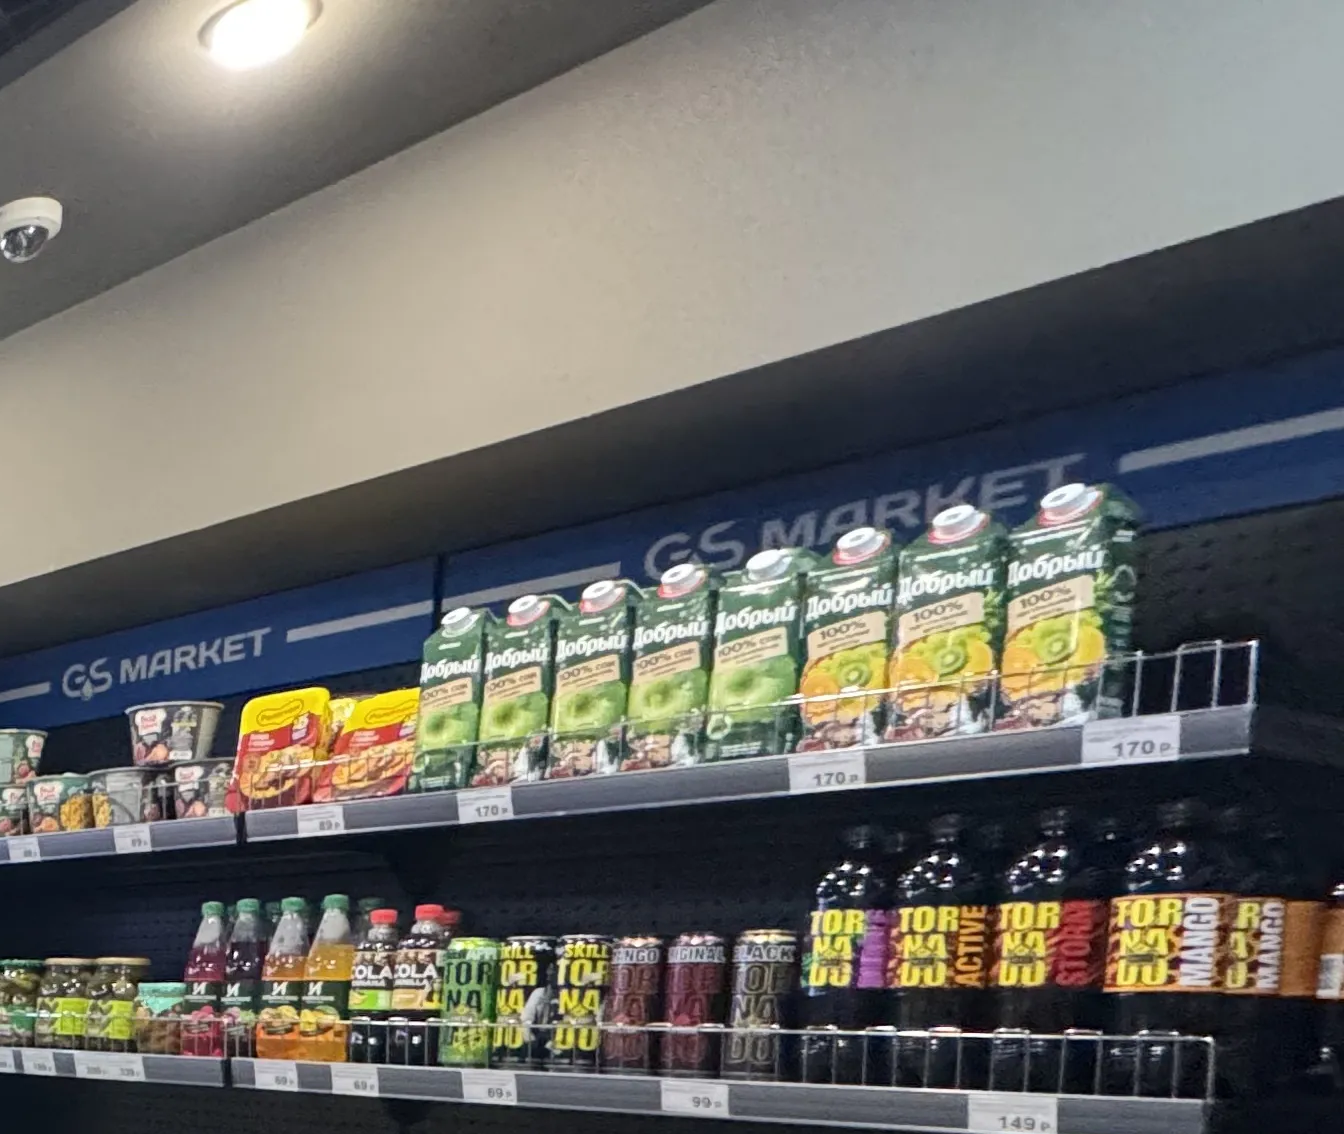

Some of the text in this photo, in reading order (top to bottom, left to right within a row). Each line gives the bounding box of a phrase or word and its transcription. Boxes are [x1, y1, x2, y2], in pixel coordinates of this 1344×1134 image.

[62, 628, 273, 700] GS MARKET
[1113, 741, 1156, 760] 170
[813, 772, 845, 787] 170
[475, 804, 500, 818] 170
[810, 908, 865, 935] TOR
[899, 906, 961, 932] TOR
[999, 902, 1062, 930] TOR
[1116, 898, 1185, 928] TOR
[955, 905, 989, 988] ACTIVE
[1180, 897, 1221, 987] MANGO
[559, 989, 601, 1016] NA
[997, 1115, 1037, 1132] 149
